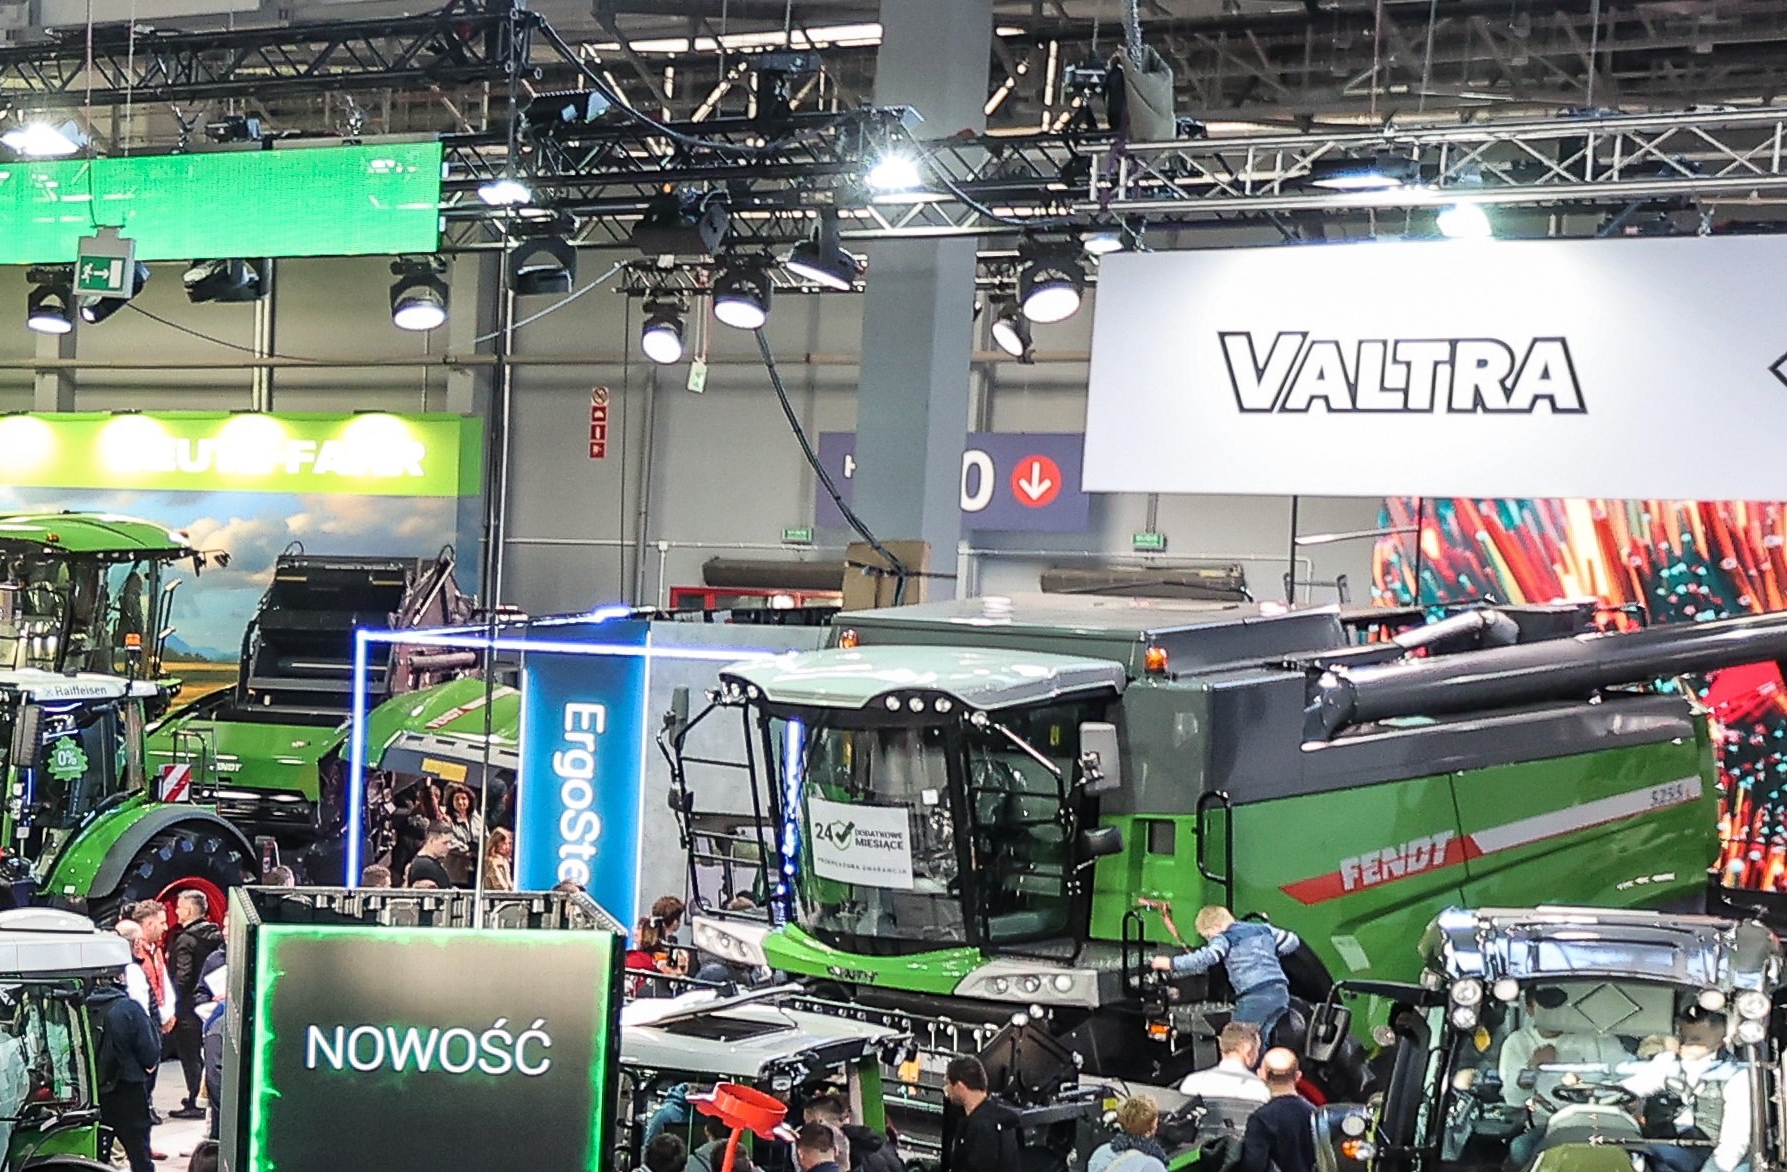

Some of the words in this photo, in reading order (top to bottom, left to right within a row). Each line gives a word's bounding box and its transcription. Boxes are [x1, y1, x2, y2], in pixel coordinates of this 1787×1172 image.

[1217, 331, 1588, 414] VALTRA
[54, 685, 108, 698] Raiffeisen
[57, 750, 77, 767] 0%
[552, 702, 606, 887] ErgoSte
[814, 821, 834, 842] 24
[854, 828, 903, 840] DODATKOWE
[855, 838, 905, 852] MIESIĄCE
[1339, 830, 1455, 891] FENDT
[305, 1017, 553, 1076] NOWOŚĆ
